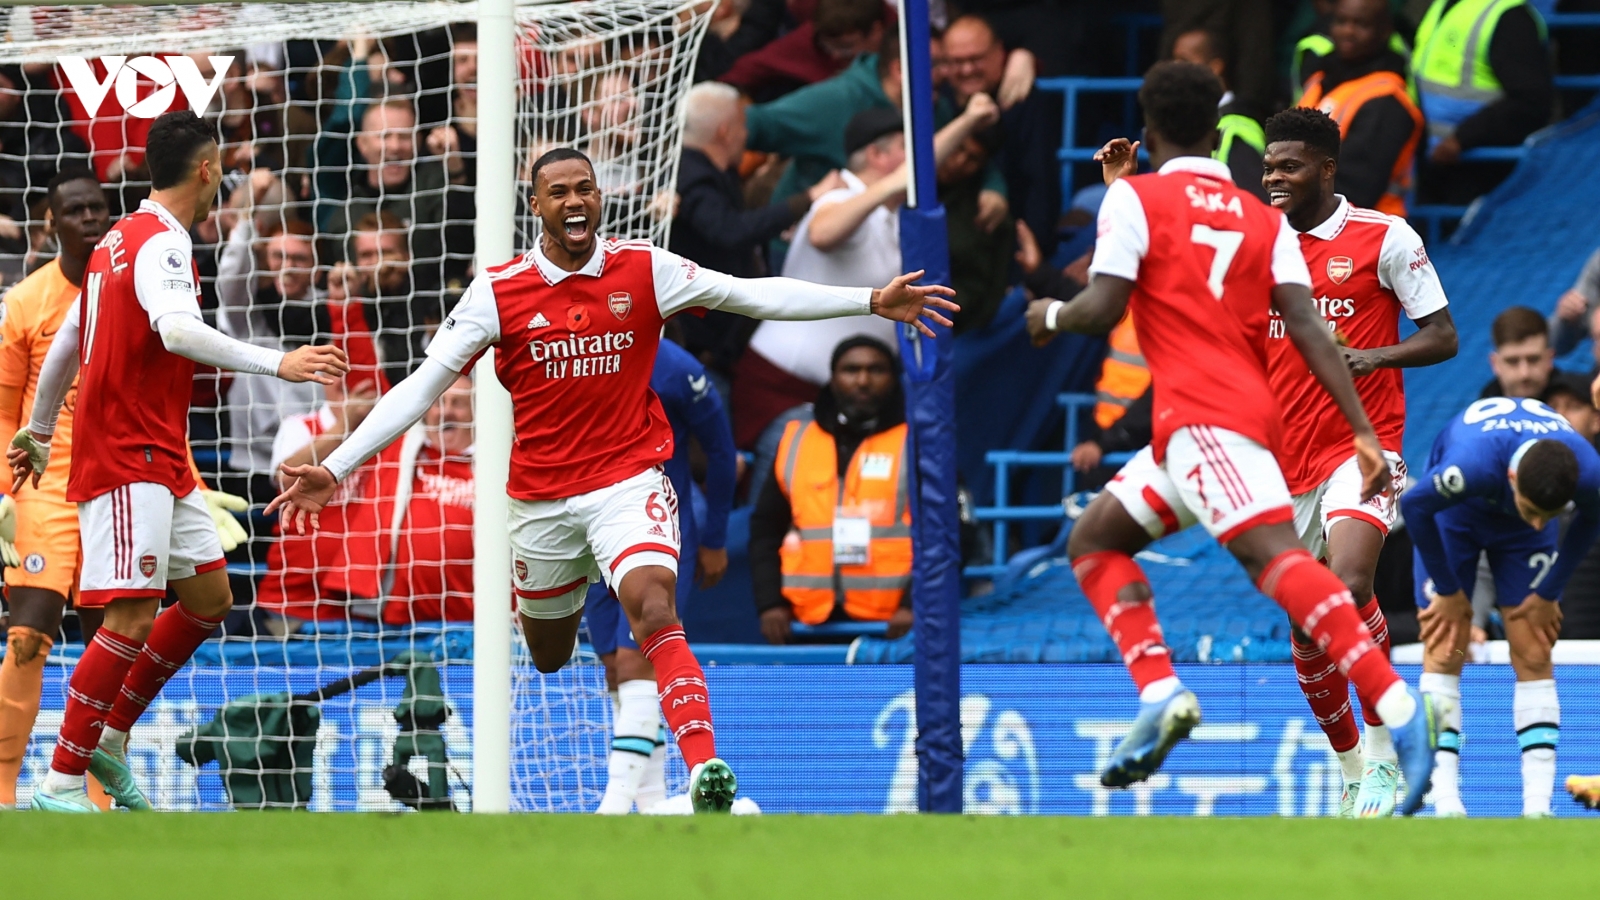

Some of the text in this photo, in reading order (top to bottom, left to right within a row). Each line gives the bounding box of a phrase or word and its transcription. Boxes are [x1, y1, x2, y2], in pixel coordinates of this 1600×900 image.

[1190, 223, 1245, 302] 7
[83, 272, 102, 365] 11
[527, 320, 551, 330] adidas
[1268, 319, 1286, 339] FLY
[528, 330, 634, 362] Emirates
[545, 354, 621, 379] FLY BETTER
[645, 491, 667, 523] 6
[1528, 551, 1560, 590] 2
[672, 693, 706, 710] AFC
